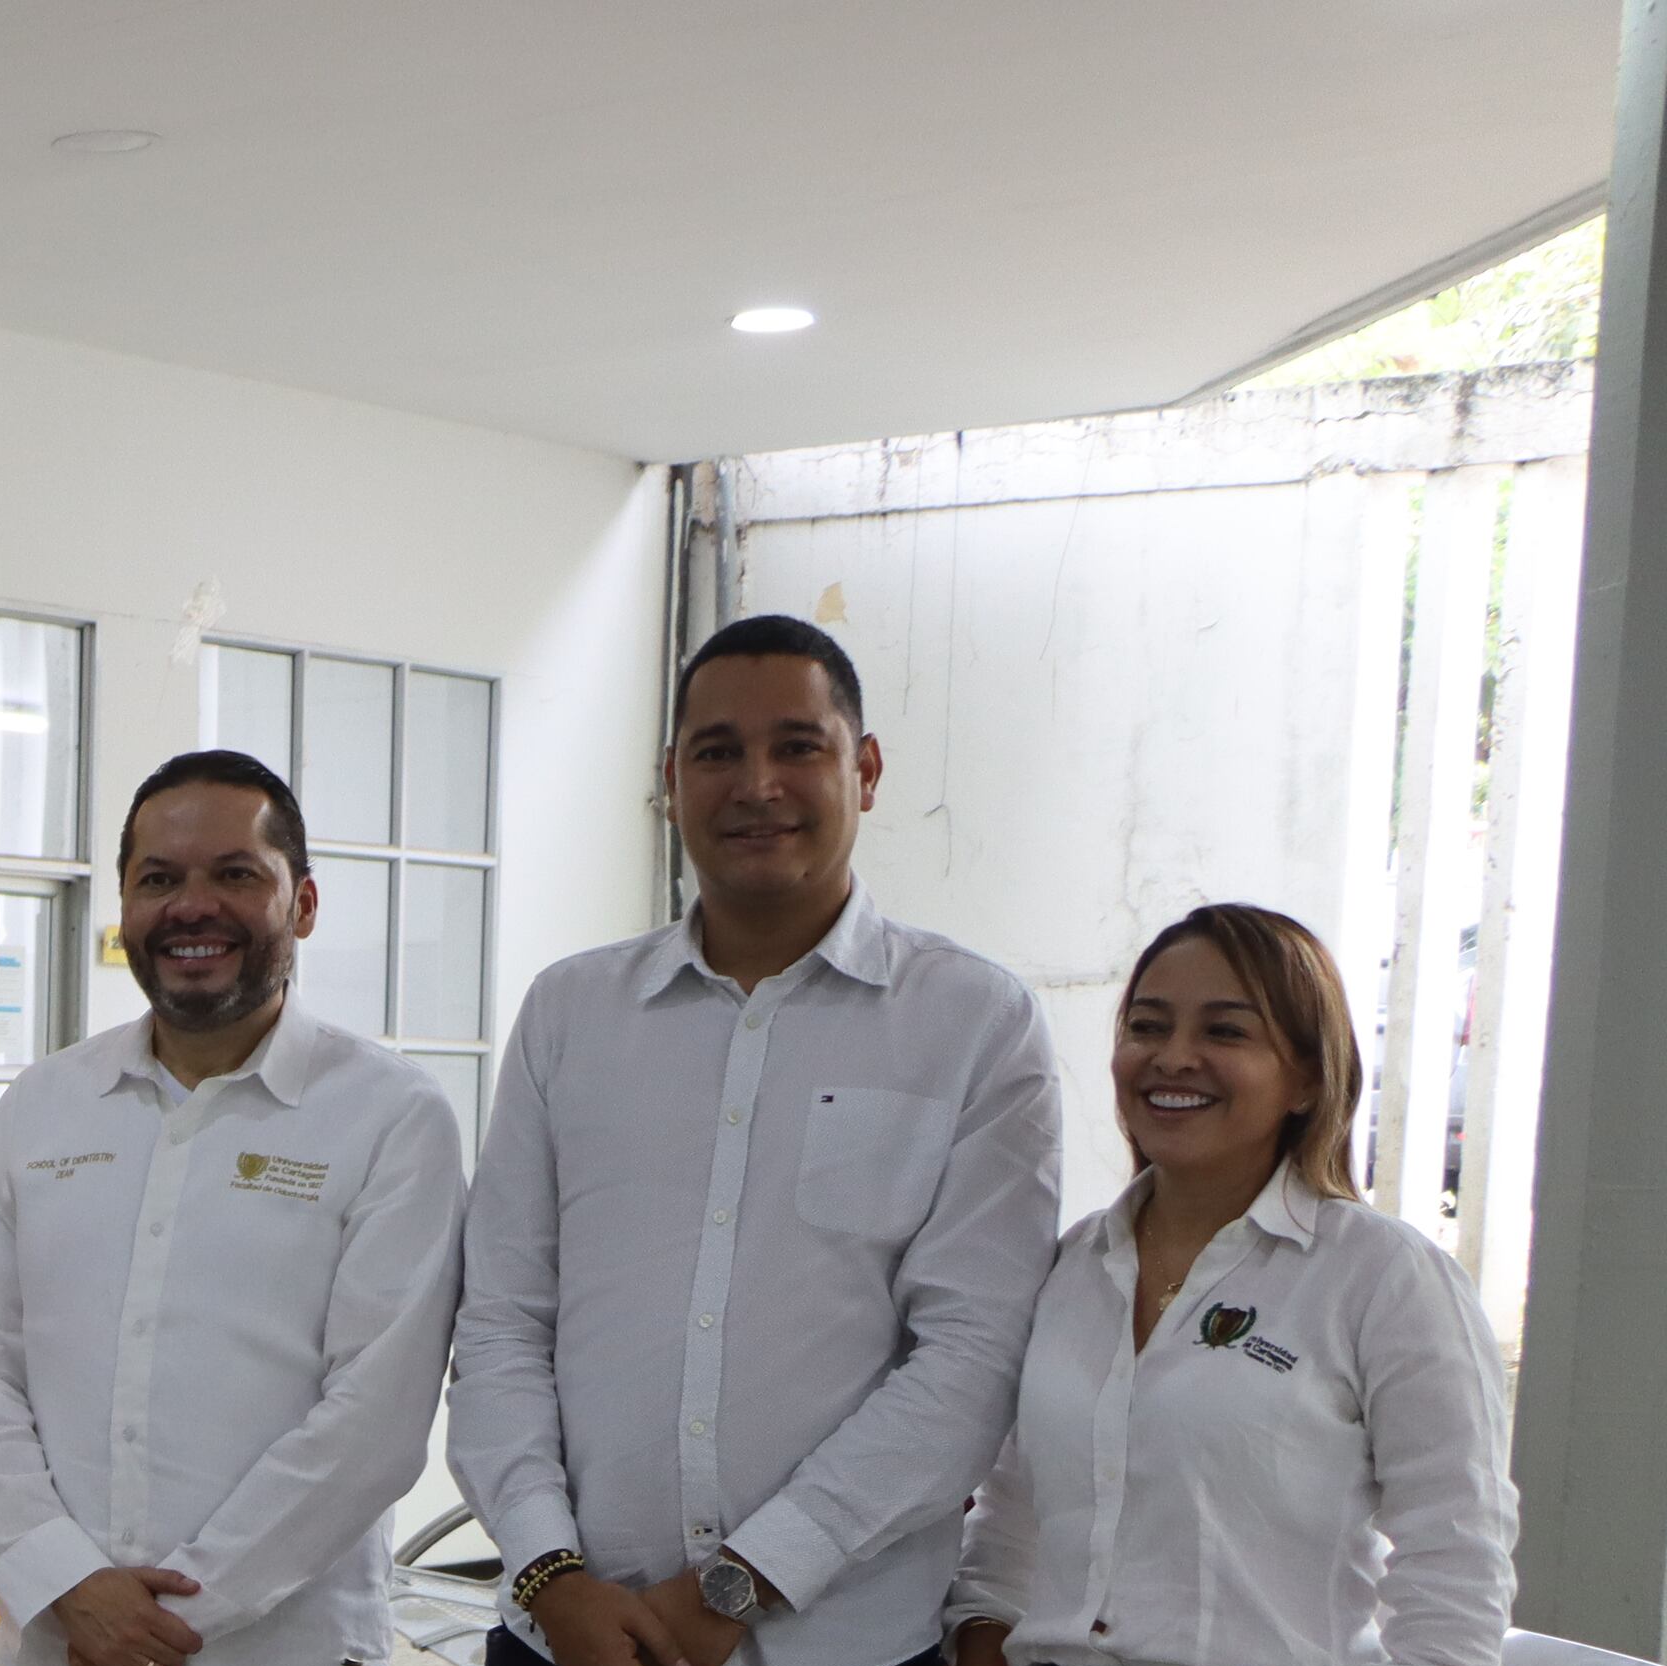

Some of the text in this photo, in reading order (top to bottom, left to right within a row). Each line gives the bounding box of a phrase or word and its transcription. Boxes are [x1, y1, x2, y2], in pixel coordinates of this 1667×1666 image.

[26, 1152, 117, 1170] SCHOOL OF DENTISTRY
[271, 1155, 330, 1171] Universidad
[281, 1166, 327, 1180] Cartagena
